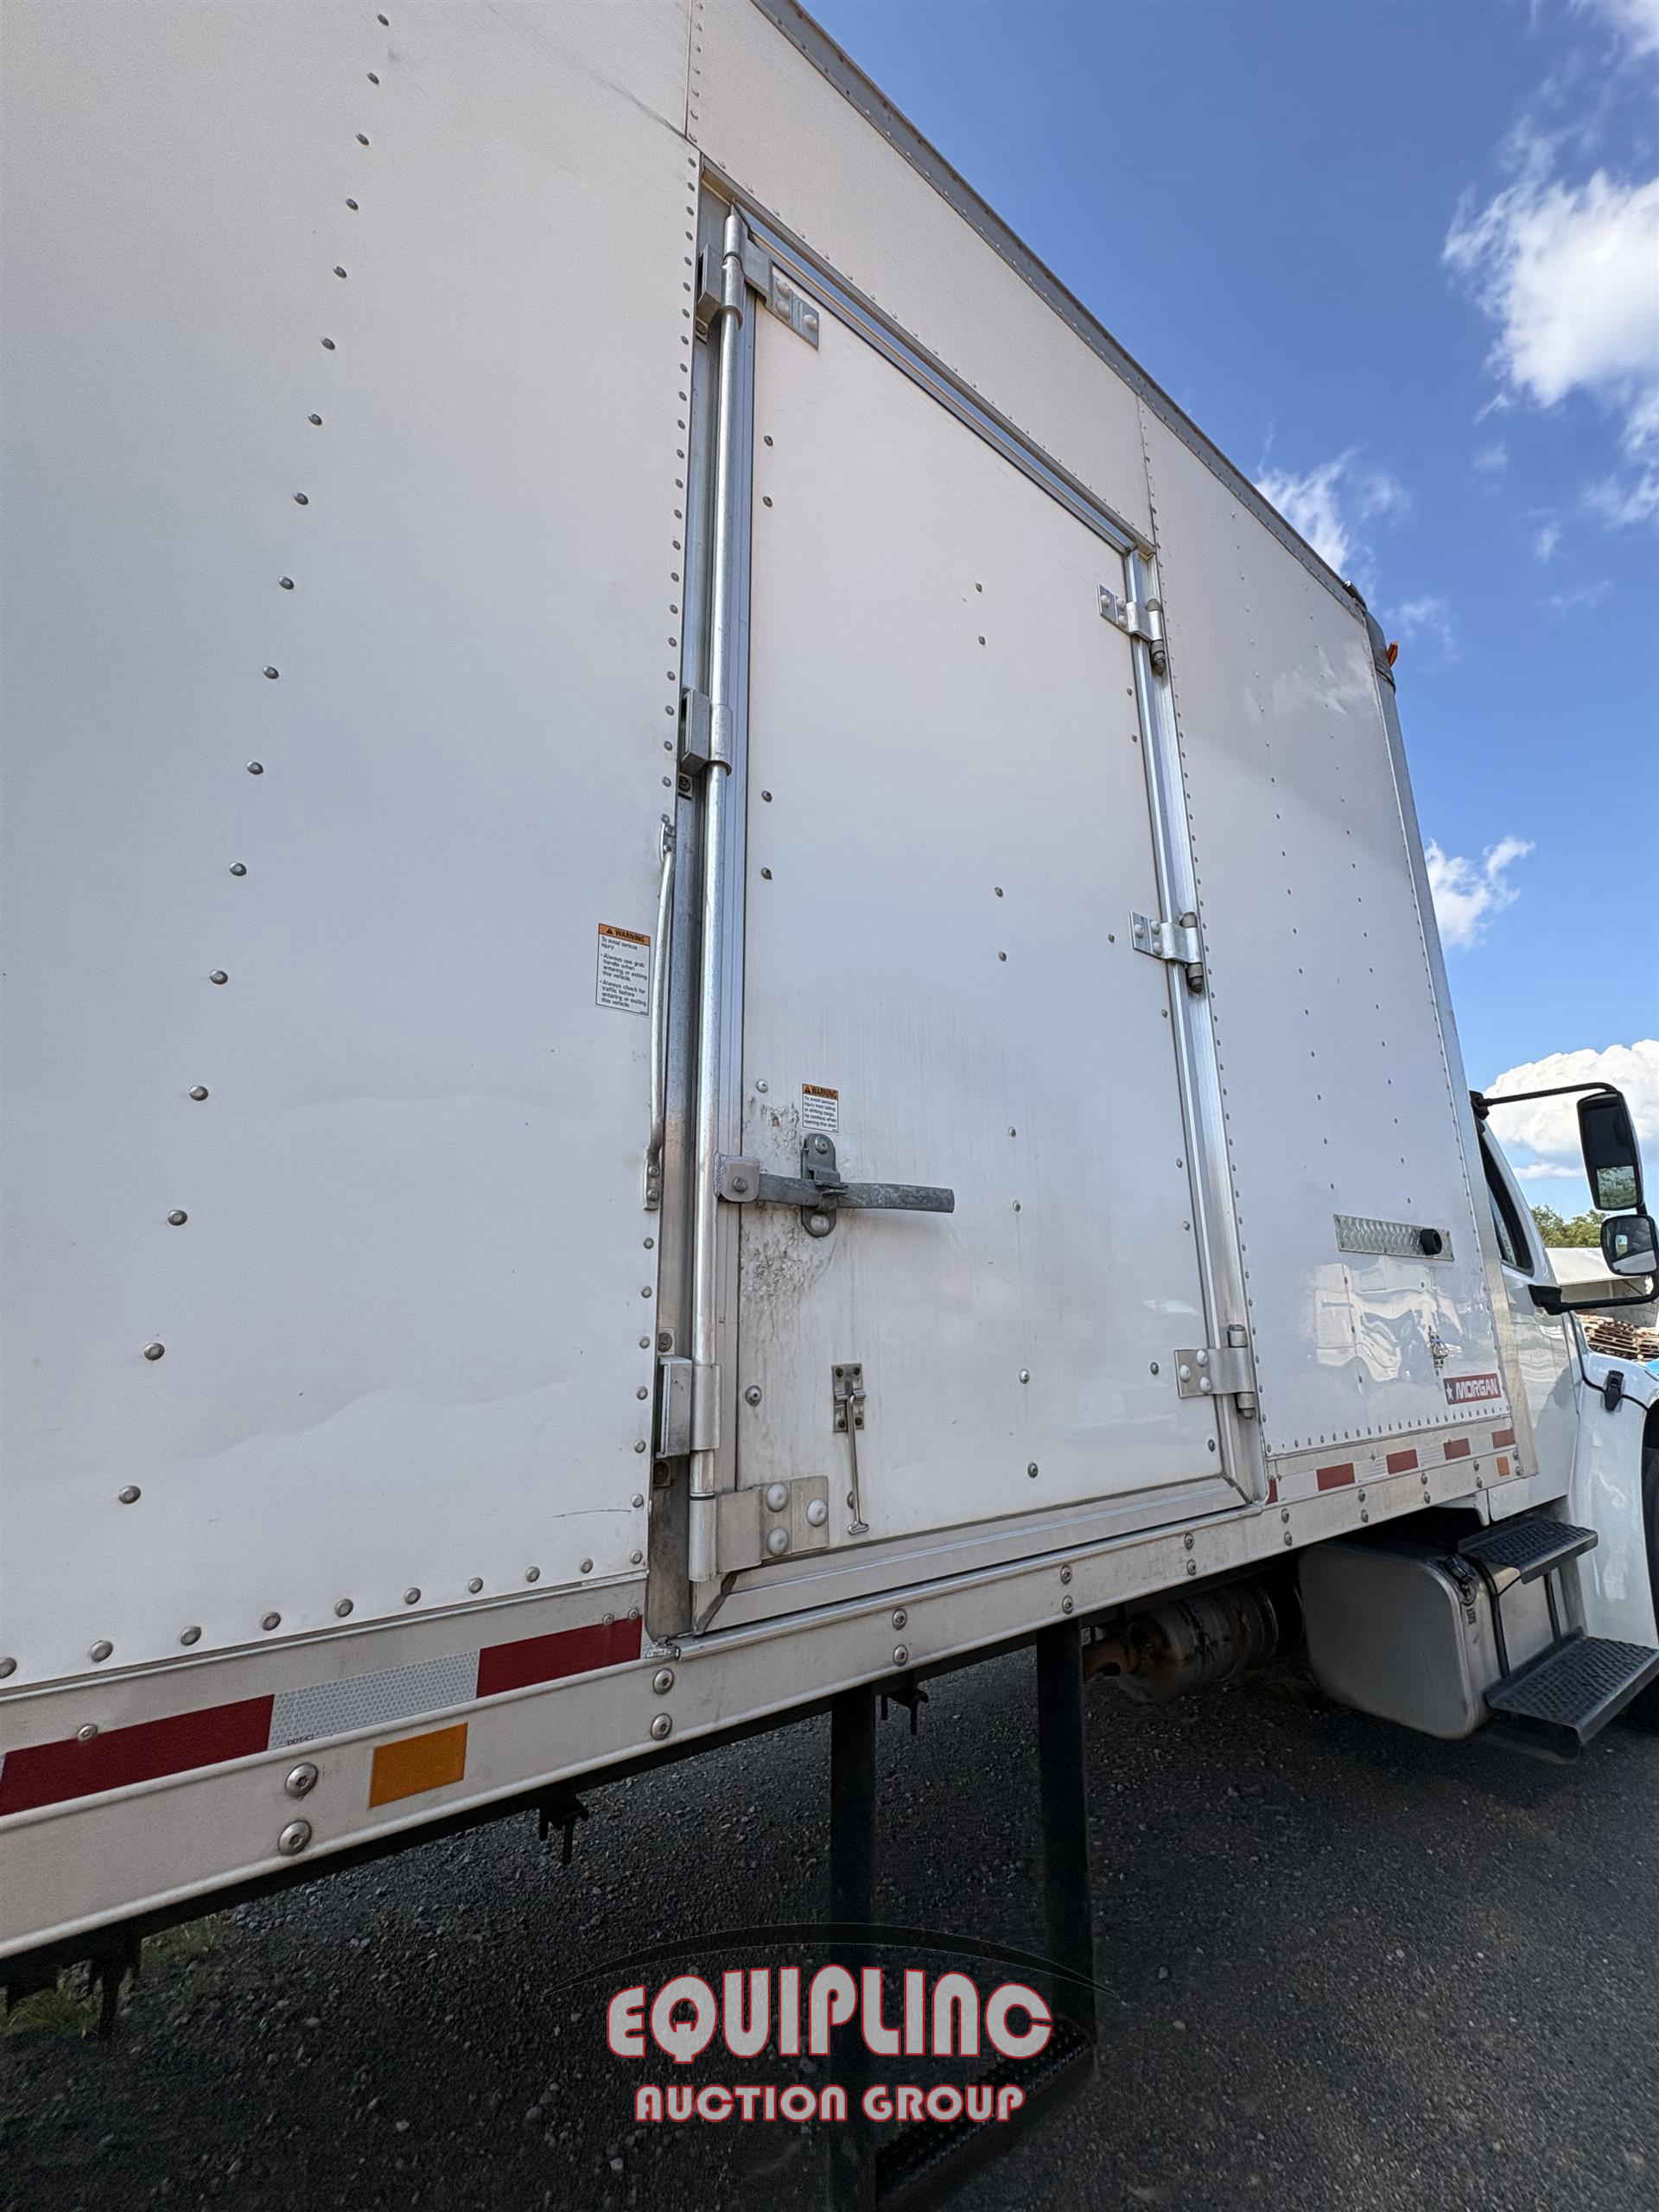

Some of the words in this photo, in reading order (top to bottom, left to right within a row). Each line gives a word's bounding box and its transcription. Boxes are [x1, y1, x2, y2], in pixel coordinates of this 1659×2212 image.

[615, 929, 645, 943] WARNING
[603, 953, 622, 963] Always
[603, 965, 624, 976] entering
[602, 980, 621, 988] Always
[602, 992, 623, 1001] entering
[812, 1086, 837, 1098] WARNING
[1455, 1378, 1498, 1400] MORGAN
